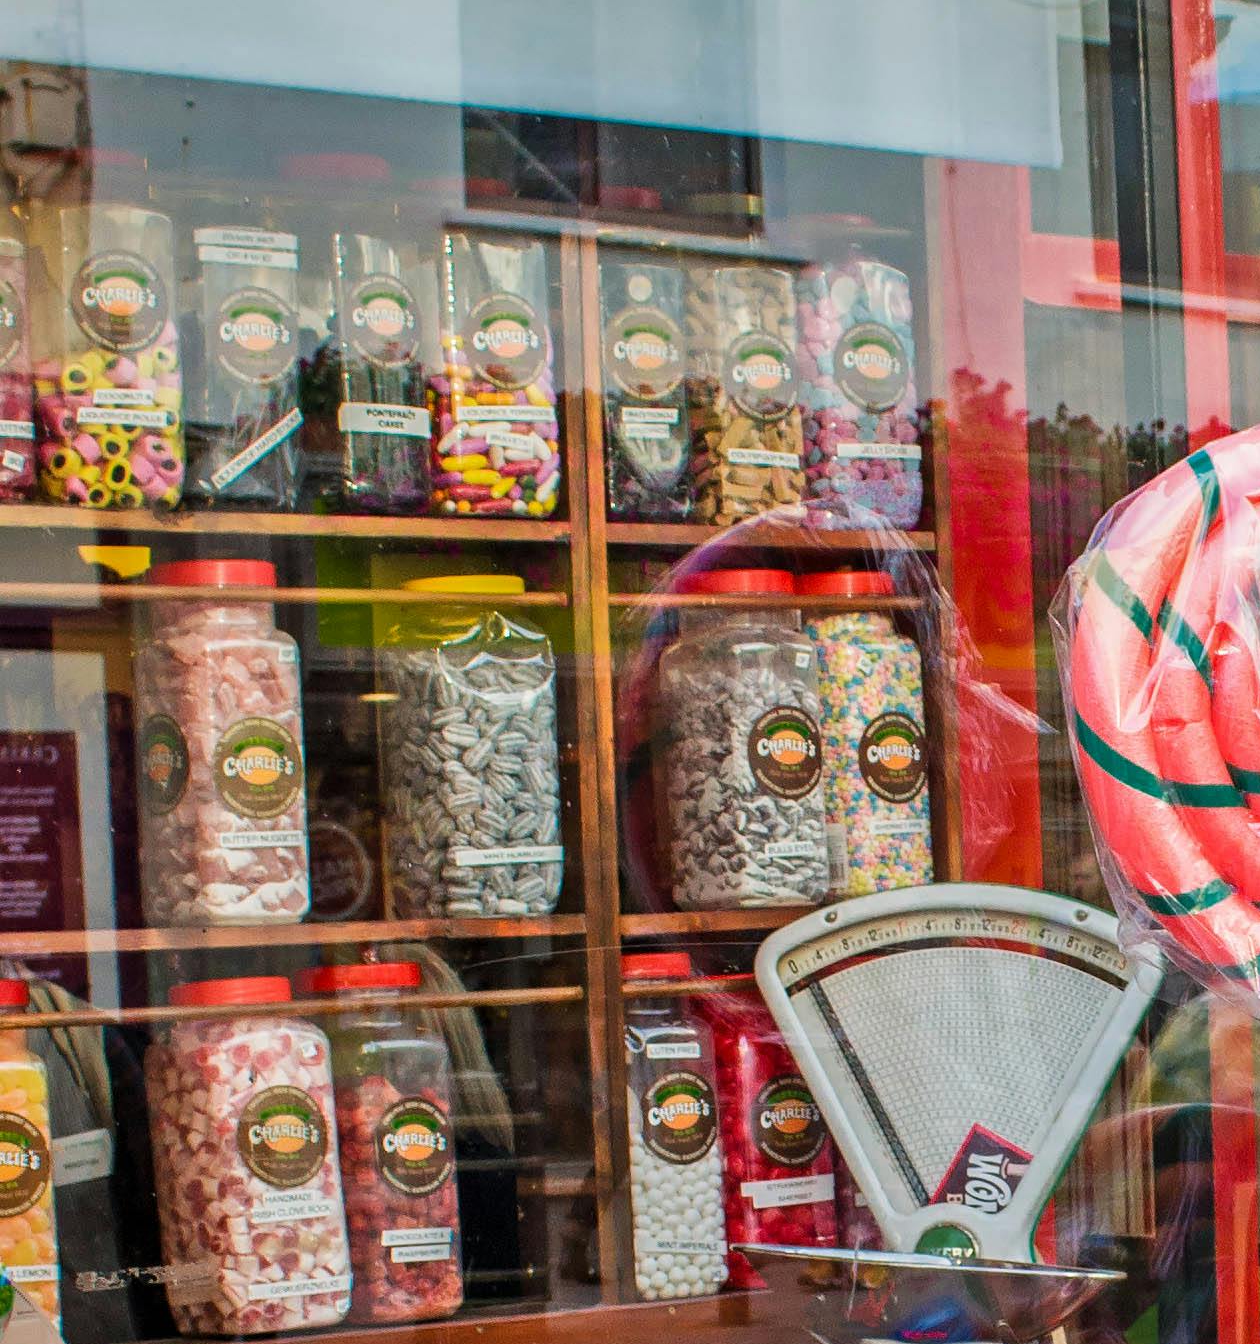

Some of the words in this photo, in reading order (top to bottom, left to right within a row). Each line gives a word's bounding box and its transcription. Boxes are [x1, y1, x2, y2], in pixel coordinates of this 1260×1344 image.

[756, 736, 817, 758] CHARLIE'S
[866, 742, 922, 764] CHARLIE'S
[223, 755, 296, 778] CHARLIE'S
[648, 1098, 710, 1127] CHARLIE'S
[760, 1105, 821, 1130] CHARLIE'S
[249, 1123, 321, 1145] CHARLIE'S
[382, 1131, 448, 1154] CHARLIE'S
